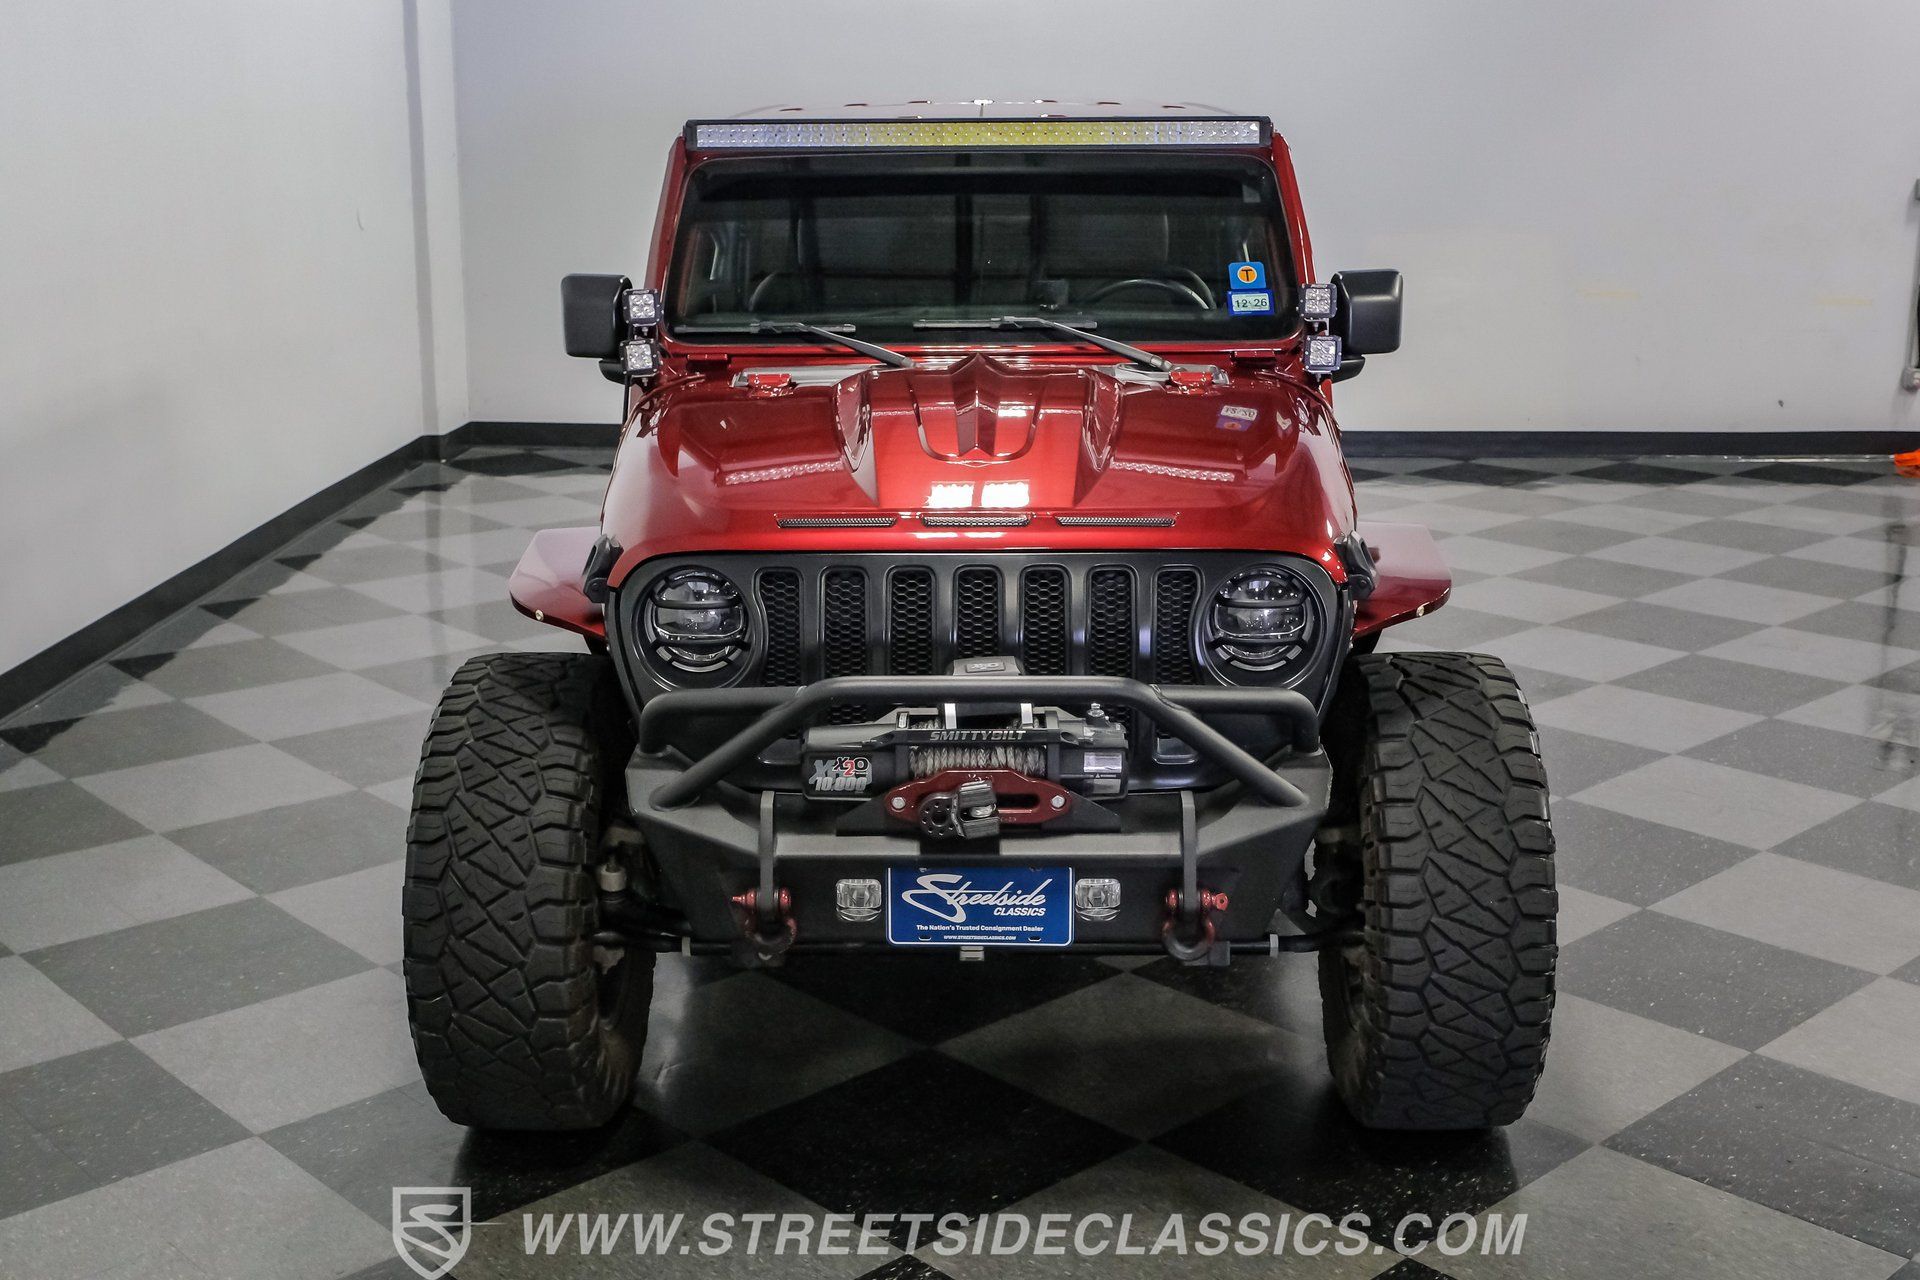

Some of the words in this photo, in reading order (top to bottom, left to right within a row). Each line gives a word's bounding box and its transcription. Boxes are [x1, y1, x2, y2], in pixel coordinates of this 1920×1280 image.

[1241, 268, 1253, 282] T
[930, 730, 1026, 741] SMITTYBILT
[901, 873, 1053, 923] Streetside
[993, 907, 1046, 917] CLASSICS
[980, 925, 1022, 933] Consignment
